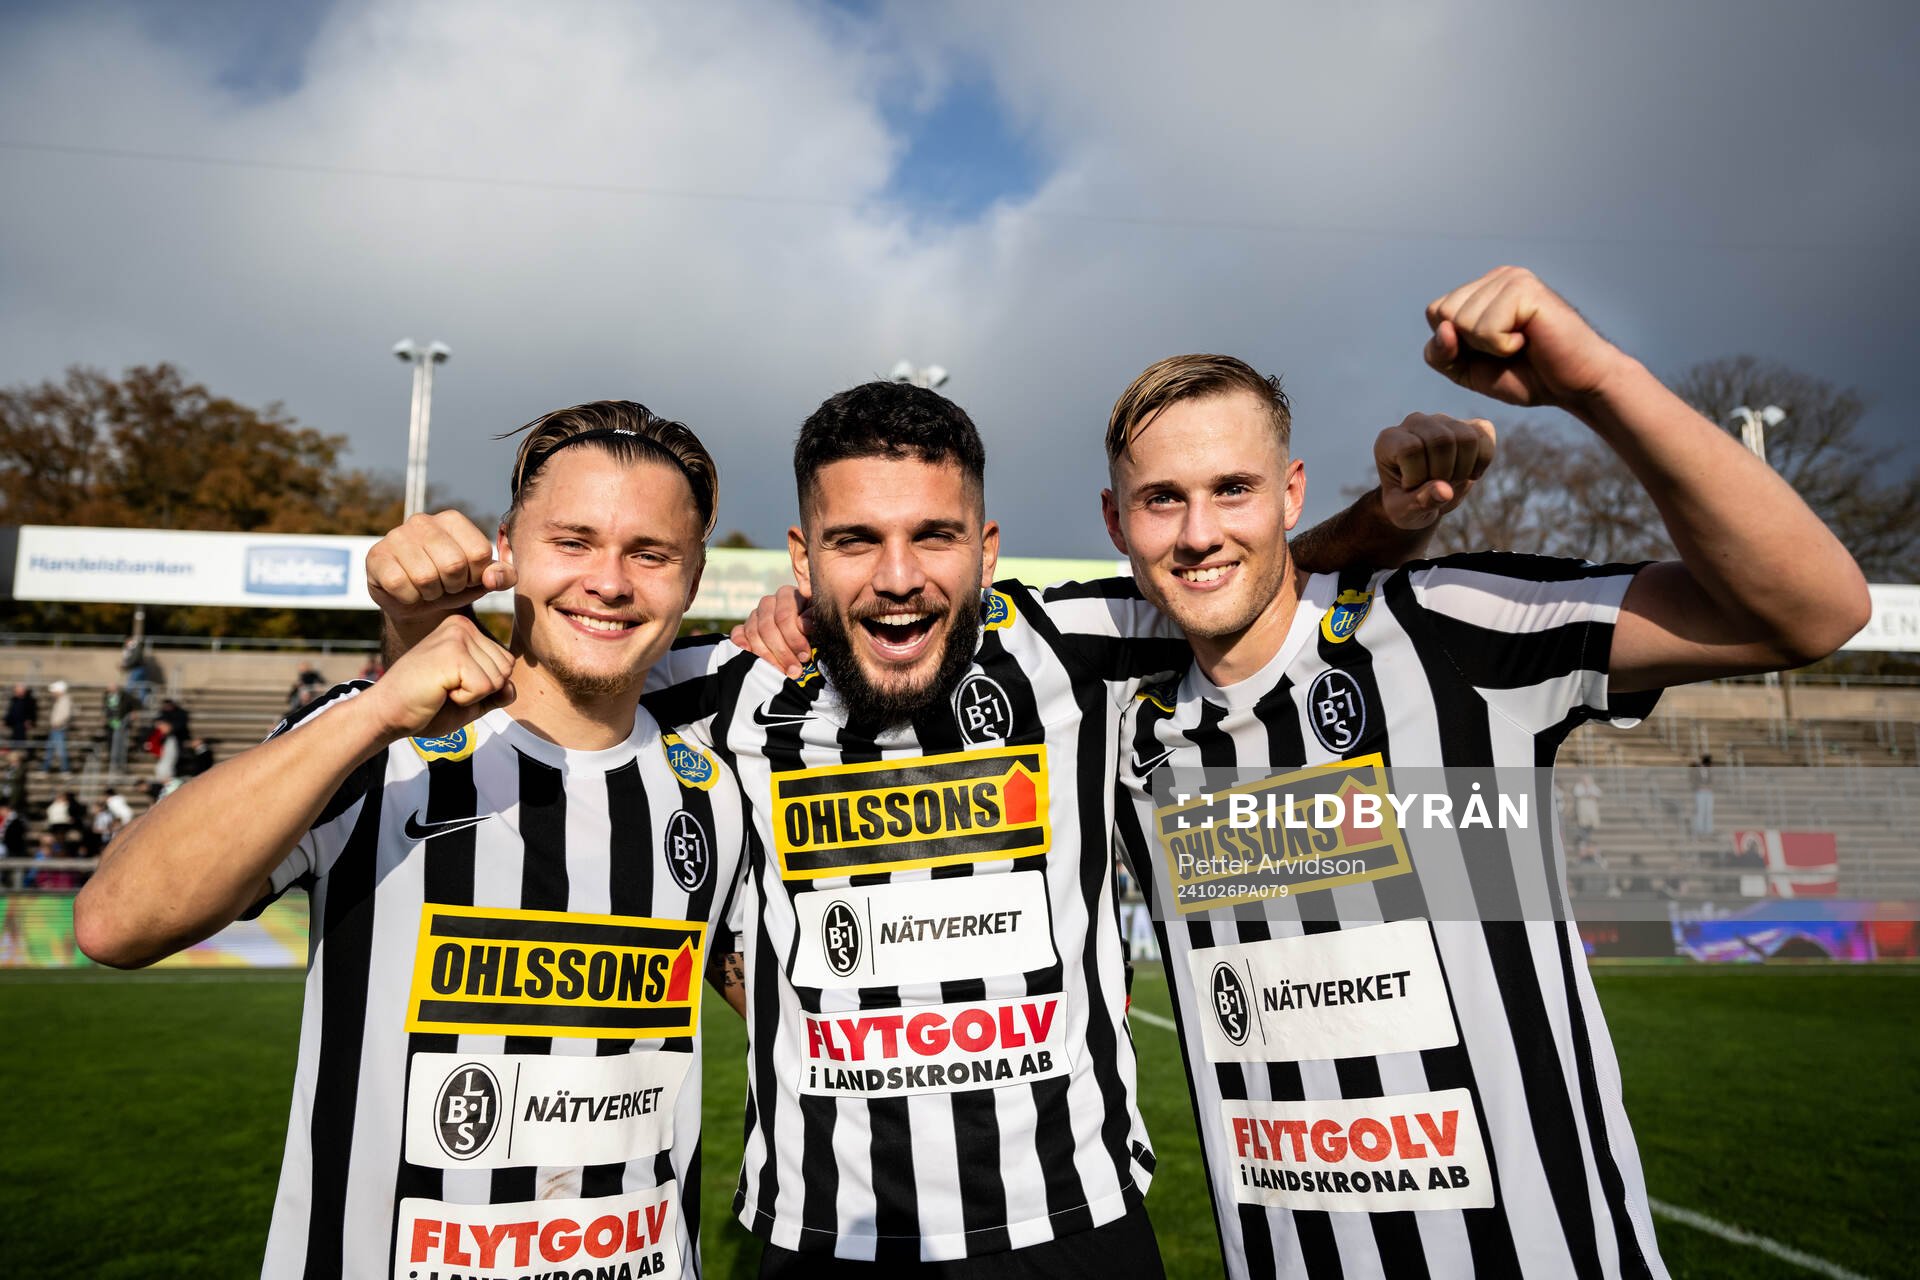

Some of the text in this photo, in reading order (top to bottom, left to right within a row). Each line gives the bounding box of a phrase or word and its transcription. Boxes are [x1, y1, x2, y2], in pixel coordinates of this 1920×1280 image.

[784, 782, 1001, 847] OHLSSONS
[880, 910, 1022, 945] NÄTVERKET
[430, 943, 669, 1002] OHLSSONS
[1264, 971, 1411, 1012] NÄTVERKET
[806, 1000, 1058, 1061] FLYTGOLV
[810, 1050, 1053, 1091] i LANDSKRONA AB
[524, 1087, 663, 1122] NÄTVERKET
[1232, 1110, 1459, 1163] FLYTGOLV
[1241, 1164, 1470, 1193] i LANDSKRONA AB
[410, 1200, 669, 1268] FLYTGOLV
